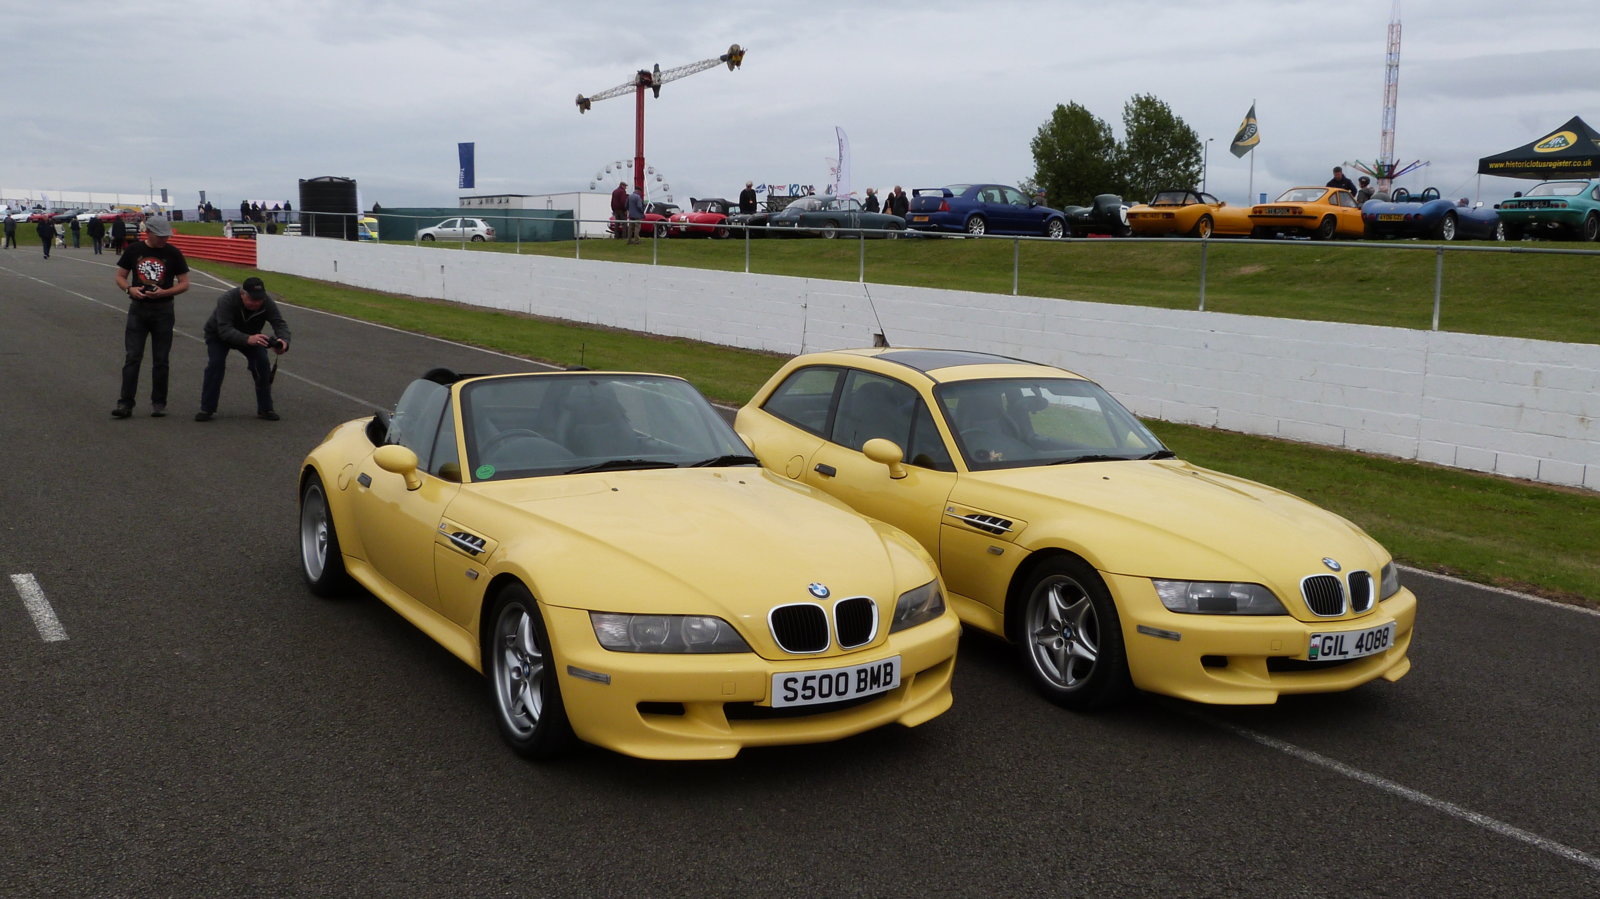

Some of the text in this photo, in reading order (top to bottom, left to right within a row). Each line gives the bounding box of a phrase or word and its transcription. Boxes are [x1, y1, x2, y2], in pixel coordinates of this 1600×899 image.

[1489, 159, 1592, 169] www.historiclotusregister.co.uk
[1321, 626, 1390, 657] GIL 4088
[783, 662, 893, 702] S500 BMB
